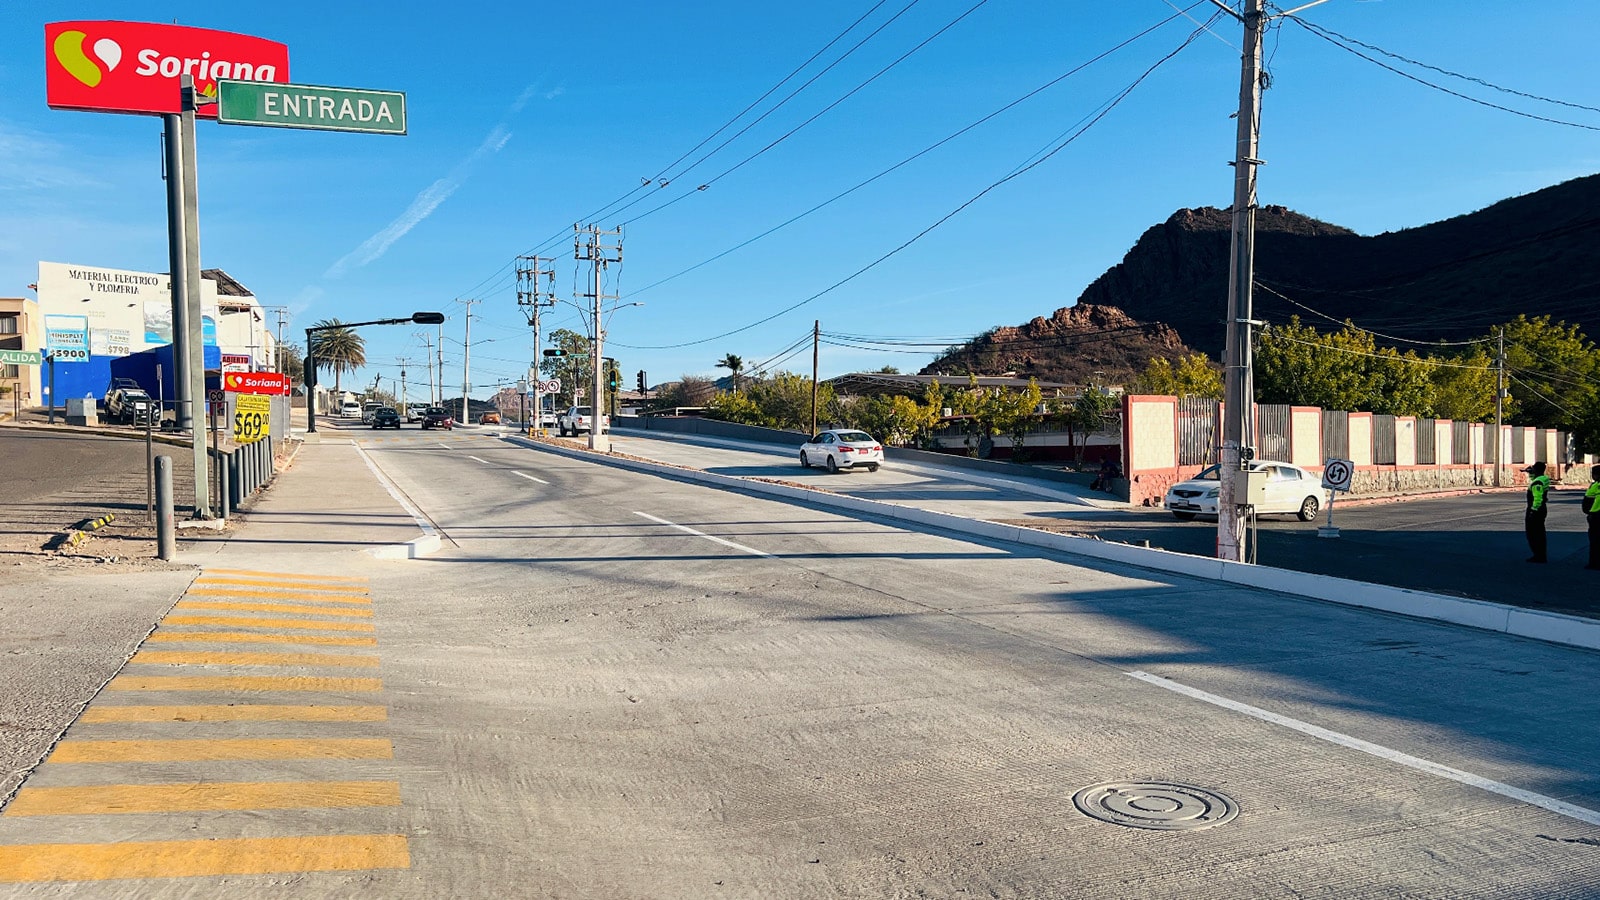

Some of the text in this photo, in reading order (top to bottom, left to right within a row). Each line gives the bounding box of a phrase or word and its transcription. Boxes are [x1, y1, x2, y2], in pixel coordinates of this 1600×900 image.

[135, 49, 276, 82] Soriana
[264, 92, 394, 123] ENTRADA
[69, 269, 112, 282] MATERIAL
[114, 274, 159, 286] ELECTRICO
[89, 282, 140, 295] Y PLOMERIA
[108, 345, 130, 355] $798
